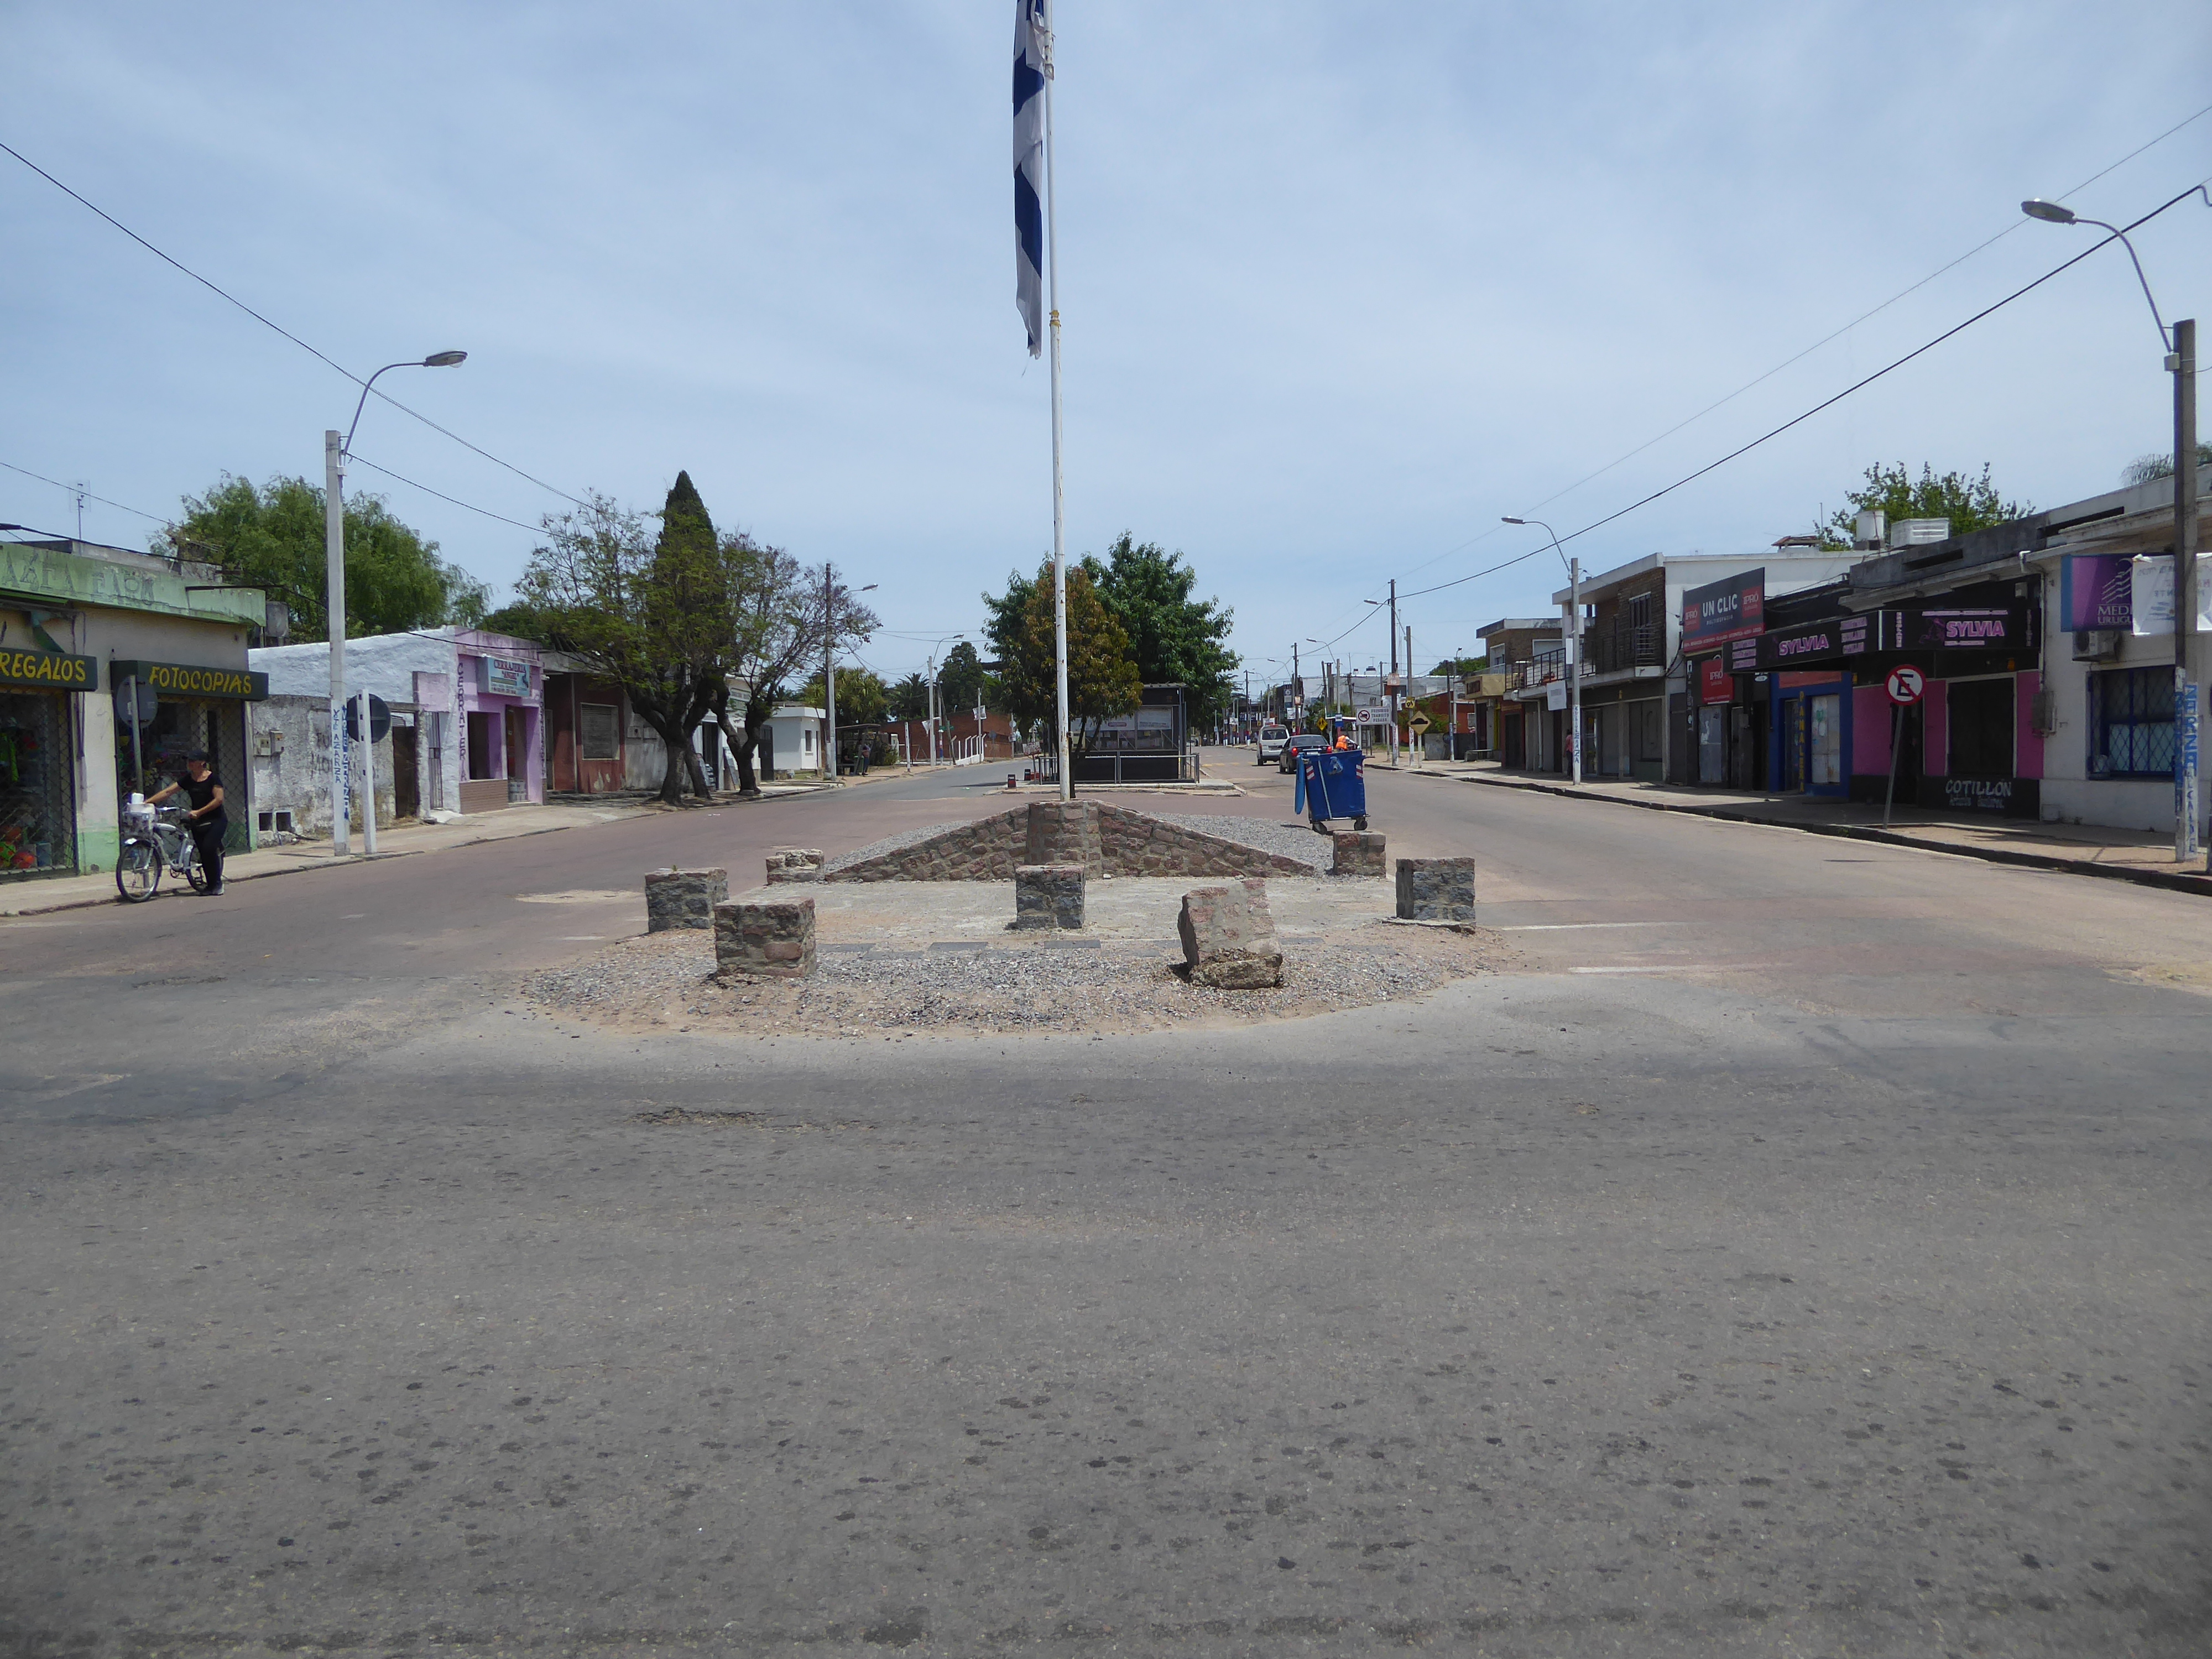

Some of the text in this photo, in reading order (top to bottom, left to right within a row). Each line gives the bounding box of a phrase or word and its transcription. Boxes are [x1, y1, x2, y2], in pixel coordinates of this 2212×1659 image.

[1702, 593, 1738, 617] UN CLIC
[1946, 620, 2005, 638] SYLVIA
[1778, 634, 1829, 656] SYLVIA
[0, 653, 86, 682] REGALOS
[149, 666, 252, 695] FOTOCOPIAS
